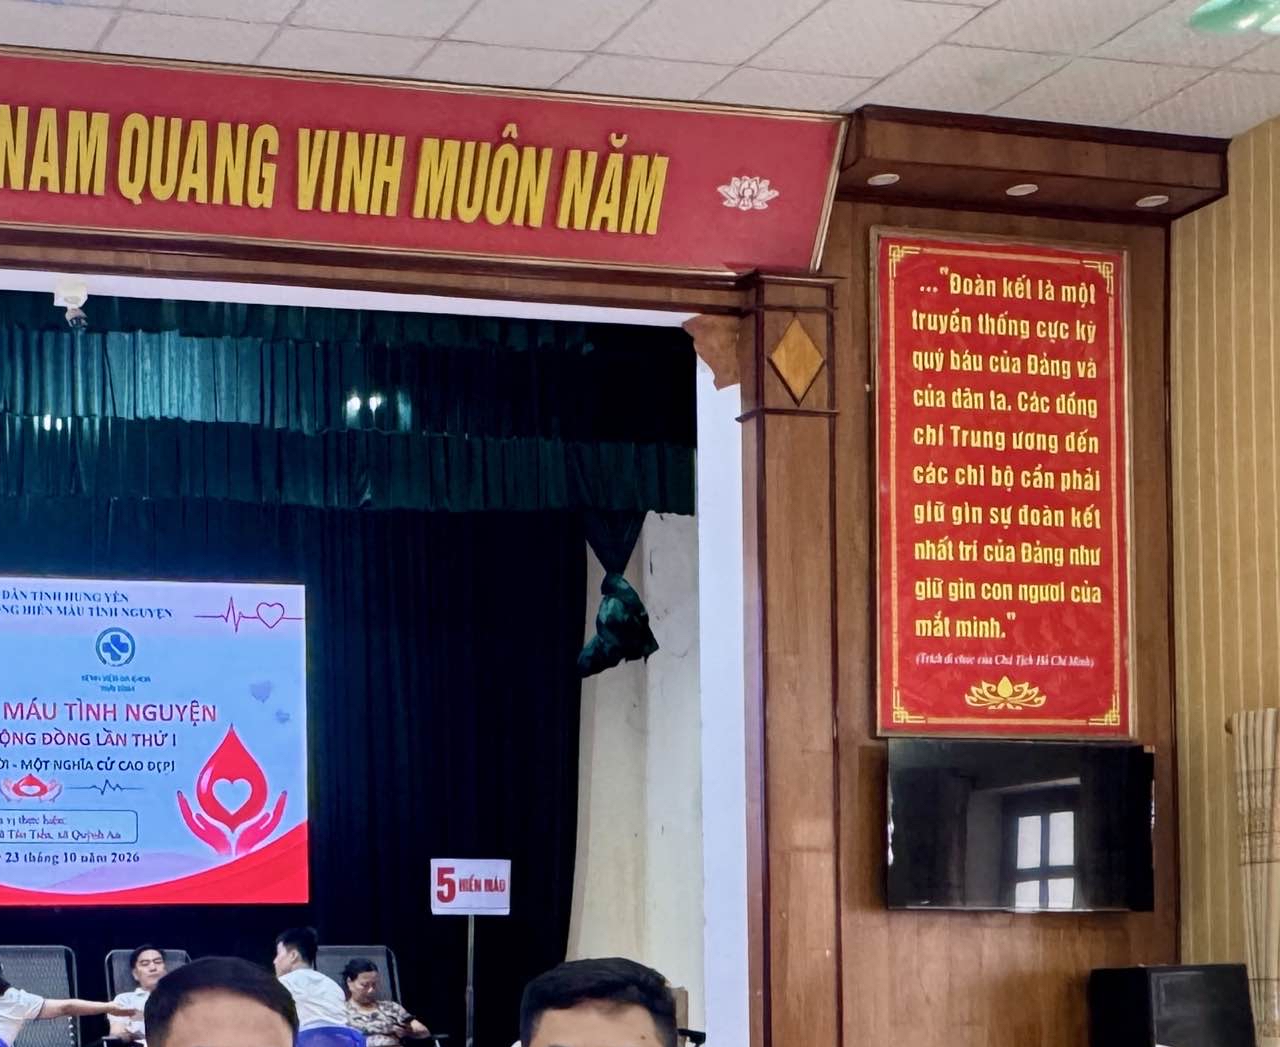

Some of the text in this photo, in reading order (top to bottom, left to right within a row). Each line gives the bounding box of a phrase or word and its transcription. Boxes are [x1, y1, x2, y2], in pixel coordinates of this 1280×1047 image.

[119, 113, 278, 209] QUANG
[299, 126, 405, 217] VINH
[415, 123, 552, 227] MUÔN
[558, 131, 668, 235] NĂM
[1003, 275, 1031, 299] kết
[1039, 280, 1054, 301] là
[1062, 282, 1095, 308] một
[978, 311, 1029, 339] thống
[1037, 321, 1069, 343] cực
[913, 348, 944, 372] quý
[990, 350, 1021, 374] của
[1027, 352, 1071, 379] Đảng
[1077, 358, 1096, 378] và
[914, 384, 945, 407] của
[952, 386, 983, 409] dân
[990, 390, 1011, 411] ta.
[914, 424, 1098, 454] chí Trung ương đến
[913, 462, 948, 485] các
[955, 465, 984, 486] chi
[992, 466, 1013, 492] bộ
[1061, 467, 1100, 492] phải
[914, 501, 1100, 529] giữ gìn sự đoàn kết
[915, 535, 954, 561] nhất
[984, 538, 1015, 562] của
[1021, 540, 1064, 567] Đảng
[1070, 545, 1100, 566] như
[915, 577, 943, 601] giữ
[949, 578, 975, 601] gìn
[981, 582, 1012, 601] con
[1071, 580, 1101, 603] của
[3, 697, 57, 720] MÁU
[64, 698, 117, 721] TÌNH
[126, 700, 216, 726] NGUYỆN
[42, 727, 90, 746] ĐỒNG
[96, 727, 127, 747] LẦN
[21, 758, 49, 771] MỘT
[53, 758, 93, 770] NGHĨA
[119, 760, 143, 771] CAO
[64, 852, 76, 863] 10
[111, 853, 140, 863] 2026
[437, 867, 456, 903] 5
